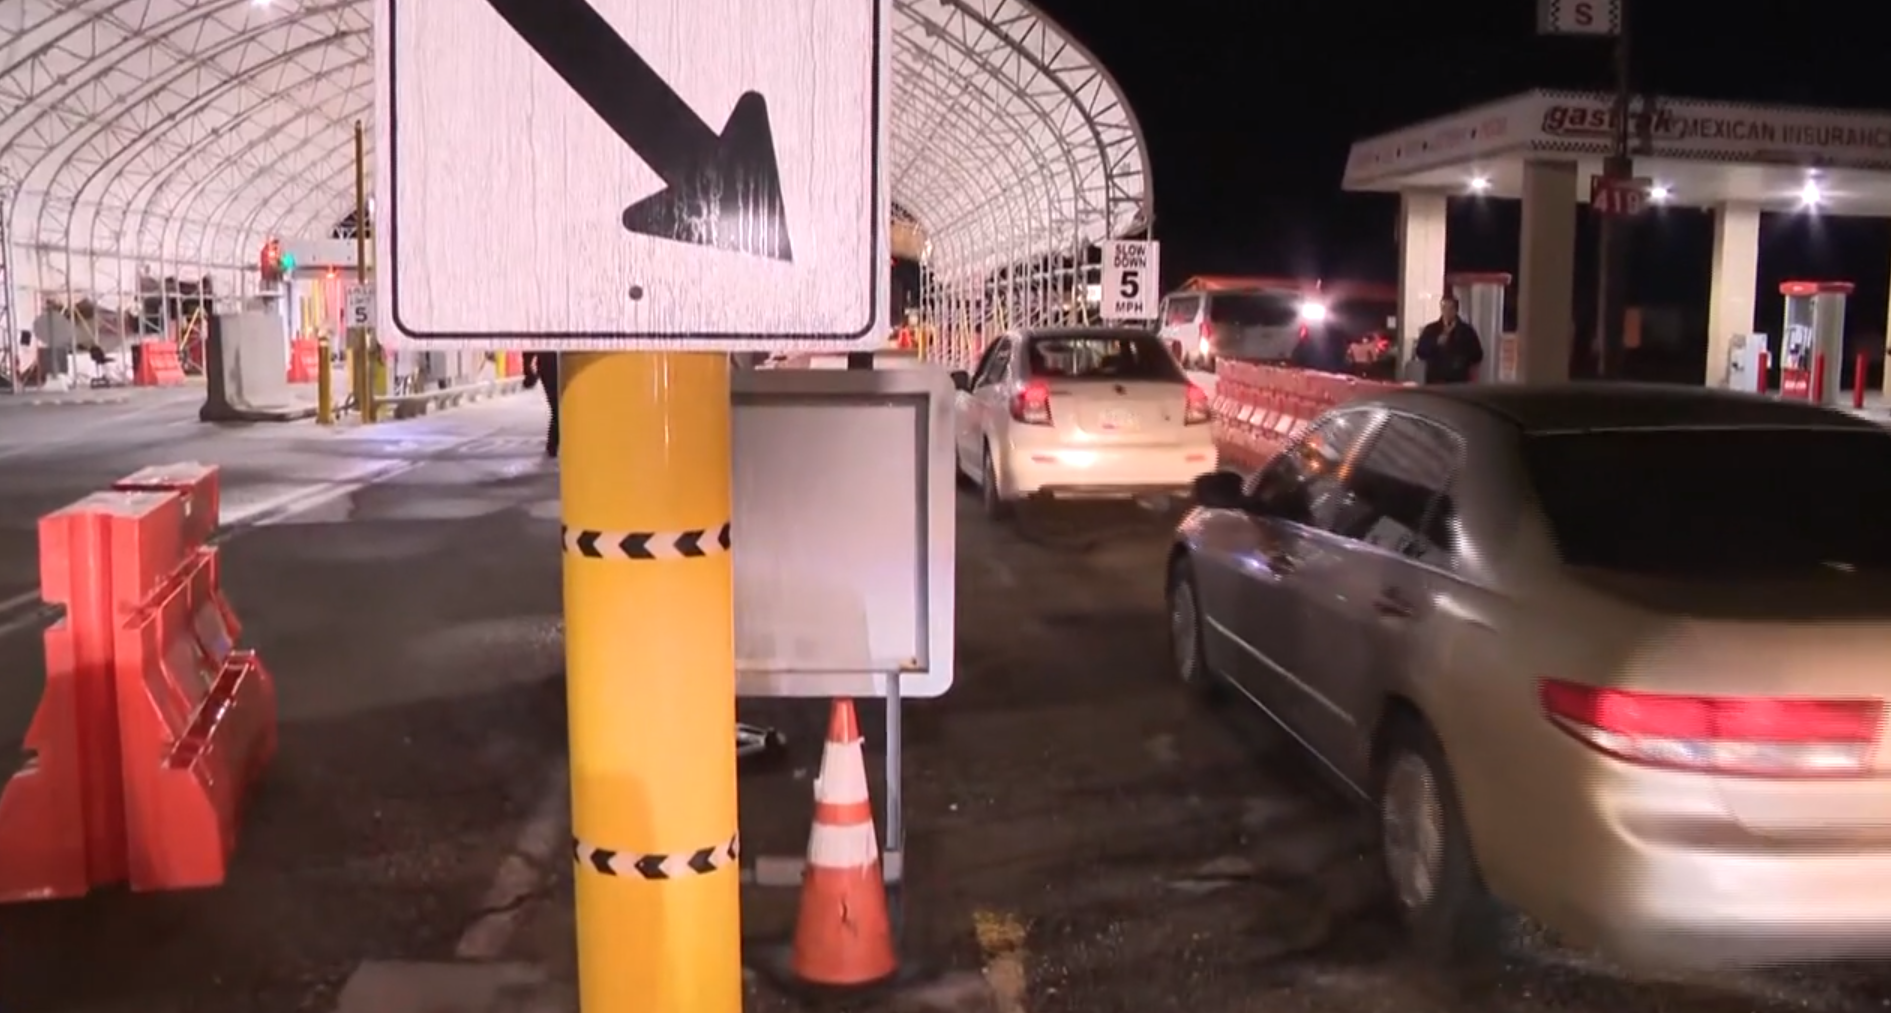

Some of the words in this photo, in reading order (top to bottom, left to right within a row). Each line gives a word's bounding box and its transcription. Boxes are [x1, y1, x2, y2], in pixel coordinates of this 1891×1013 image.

[1574, 2, 1594, 26] S
[1688, 117, 1775, 143] MEXICAN
[1783, 123, 1891, 149] INSURANC
[1115, 244, 1146, 256] SLOW
[1114, 256, 1147, 268] DOWN
[1120, 270, 1140, 299] 5
[355, 306, 368, 323] 5
[1115, 302, 1143, 313] MPH
